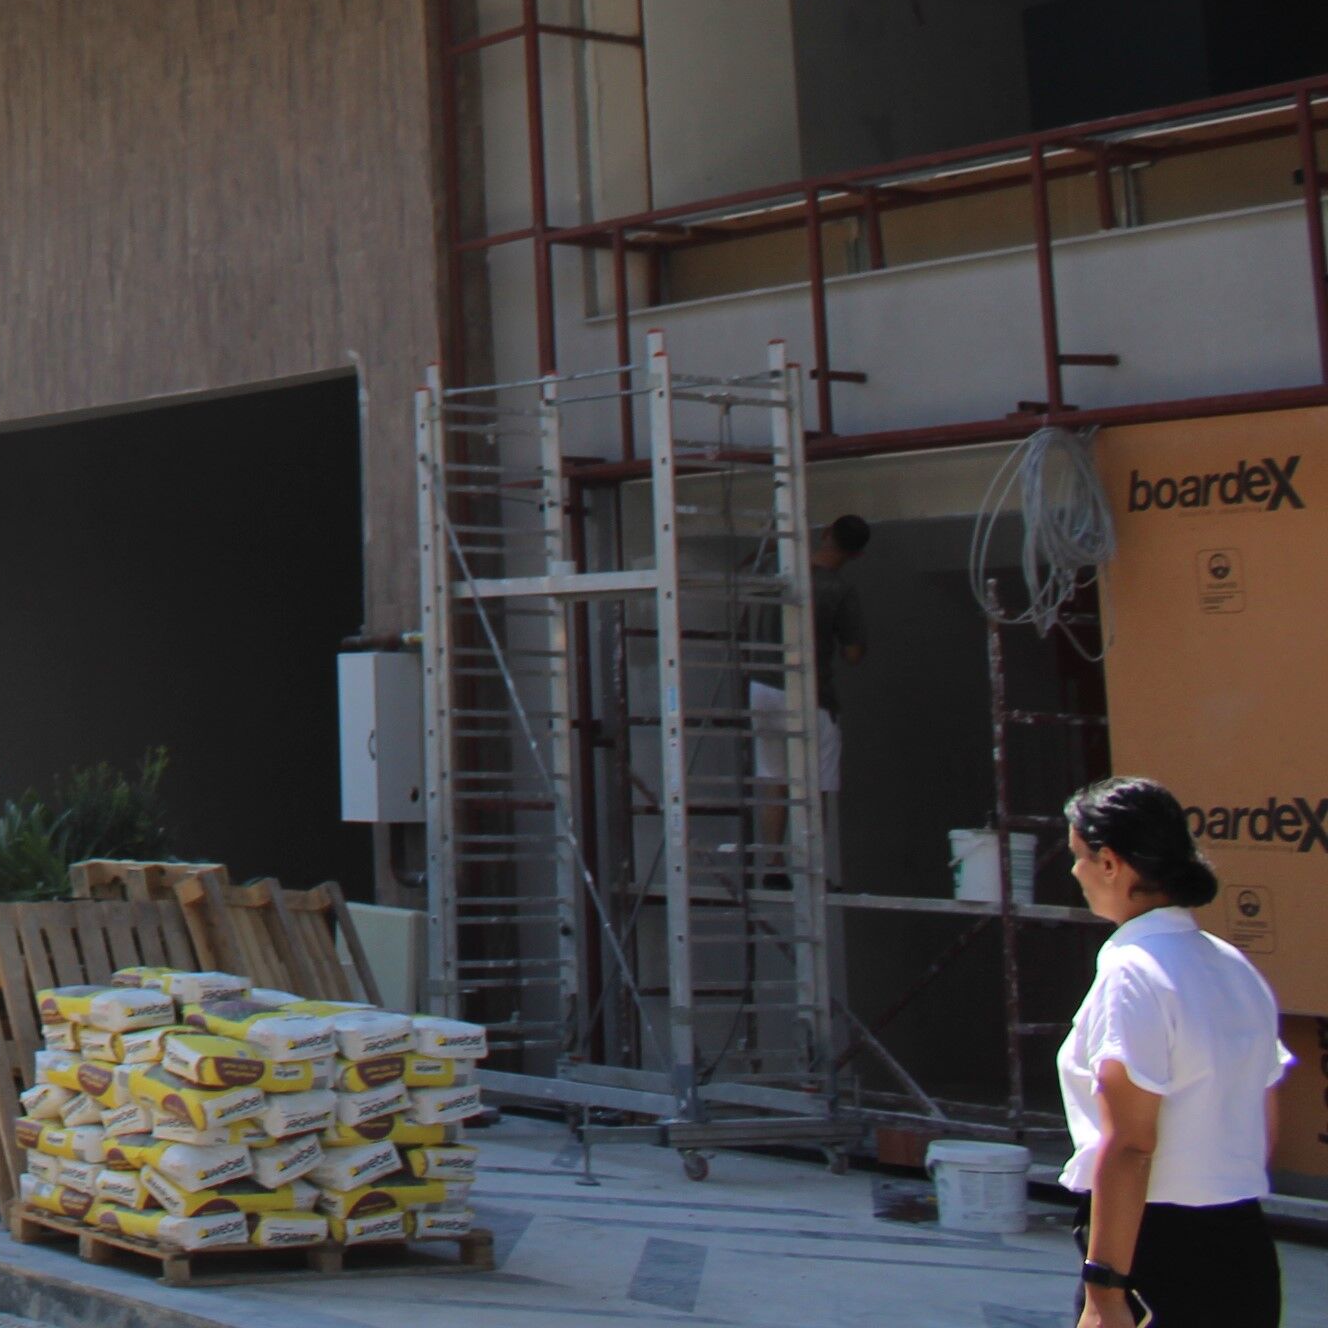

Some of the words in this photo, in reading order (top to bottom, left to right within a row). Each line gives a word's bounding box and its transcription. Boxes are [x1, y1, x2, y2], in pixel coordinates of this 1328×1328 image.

[1128, 455, 1306, 513] boardeX
[1182, 797, 1328, 853] oardeX
[449, 1036, 483, 1046] weber
[224, 1095, 262, 1115] weber
[285, 1143, 318, 1168] weber
[359, 1152, 392, 1174] weber
[364, 1218, 402, 1233] weber
